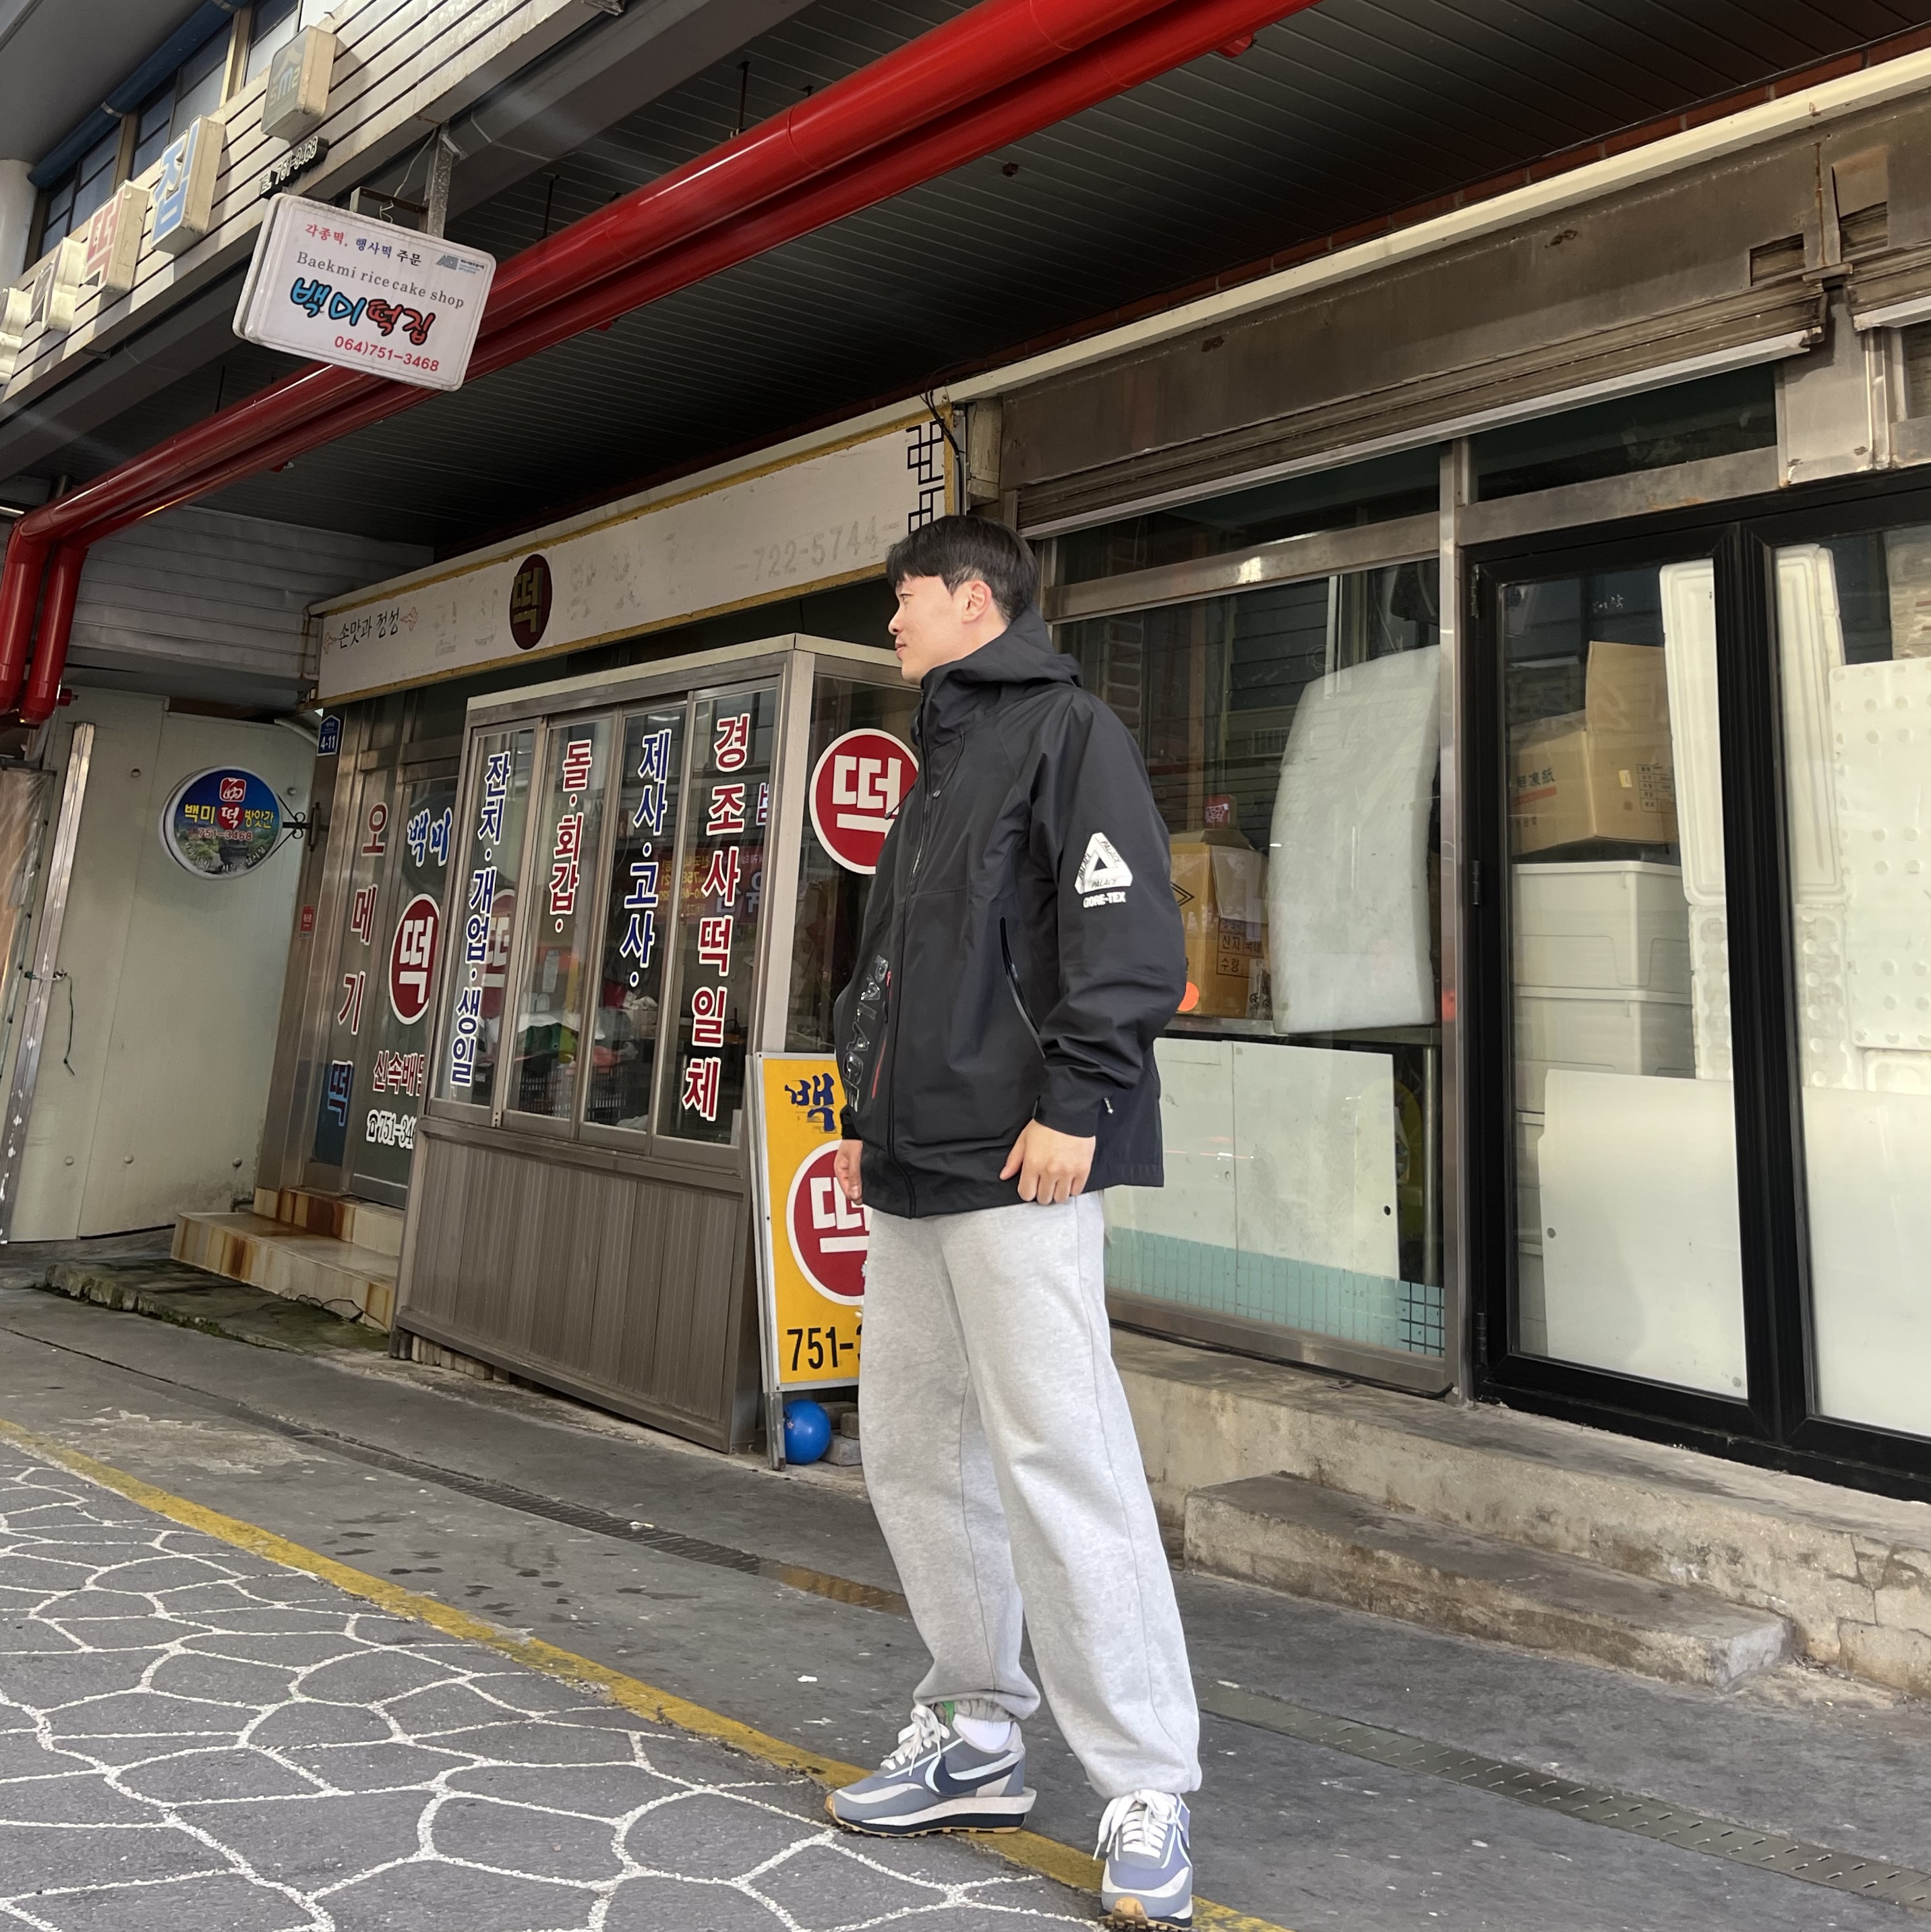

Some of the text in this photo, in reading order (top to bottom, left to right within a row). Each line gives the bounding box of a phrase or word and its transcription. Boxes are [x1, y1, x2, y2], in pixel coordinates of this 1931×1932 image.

[355, 238, 392, 258] 행사떡
[396, 250, 421, 266] 주문
[296, 251, 465, 308] Baekmi rice cake shop
[334, 336, 440, 372] 064)751-3468
[512, 567, 543, 633] 떡
[338, 616, 372, 649] 손맛과
[376, 607, 400, 639] 정성
[185, 804, 274, 829] 백미 떡 방앗간
[832, 755, 901, 840] 떡
[198, 828, 253, 841] 751-3468
[407, 807, 452, 867] 백미
[1083, 891, 1126, 908] GORE-TEX
[398, 916, 434, 1004] 떡
[1221, 958, 1239, 972] 수량
[378, 1110, 417, 1150] 751-34
[786, 1324, 863, 1372] 751-
